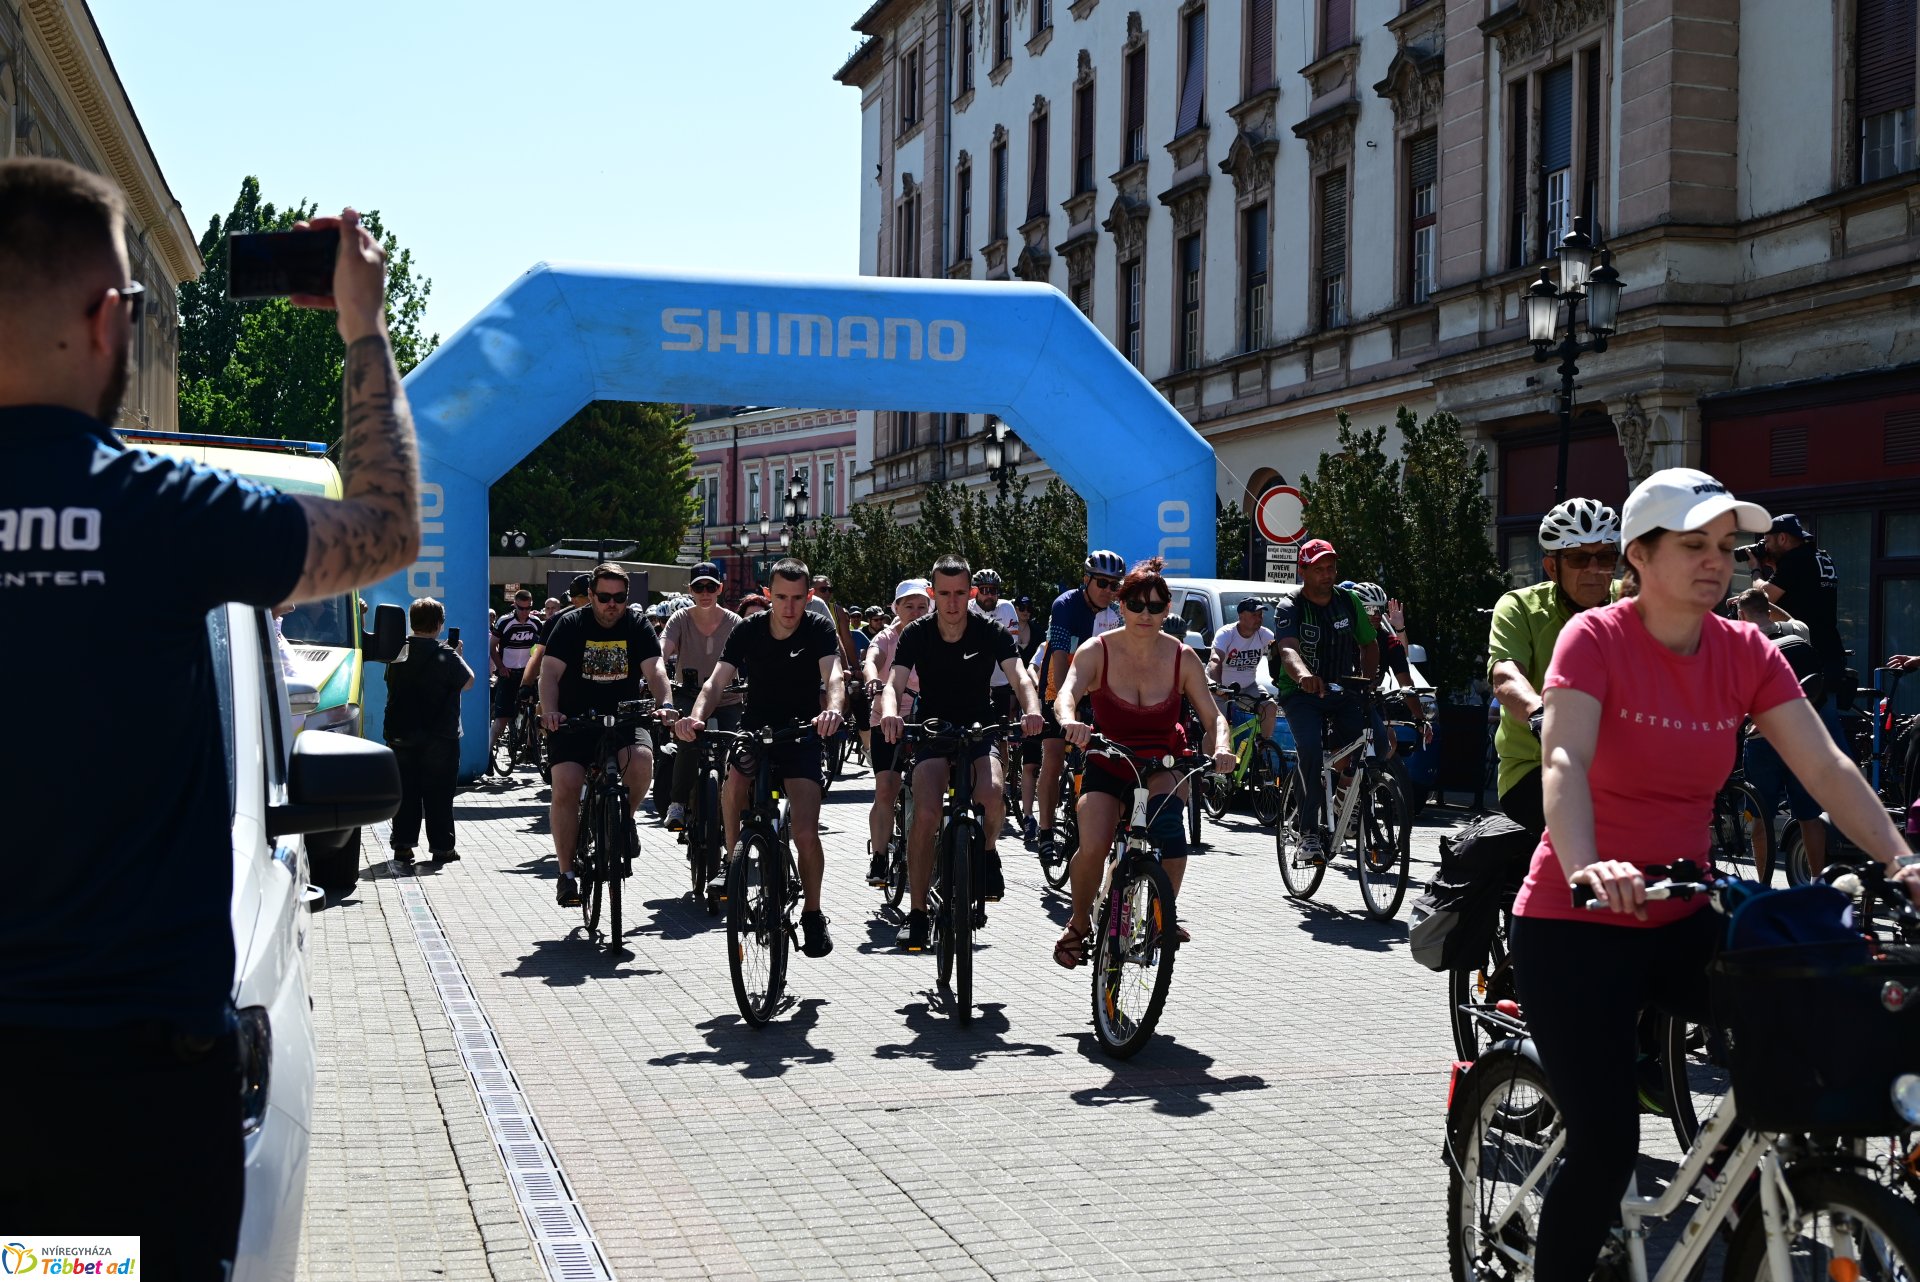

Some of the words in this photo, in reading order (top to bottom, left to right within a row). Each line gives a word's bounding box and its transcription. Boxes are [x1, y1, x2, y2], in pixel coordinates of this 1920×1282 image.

[661, 307, 966, 362] SHIMANO
[1268, 571, 1294, 580] KERÉKPÁR
[510, 630, 534, 641] KTM
[1620, 708, 1682, 730] RETRO
